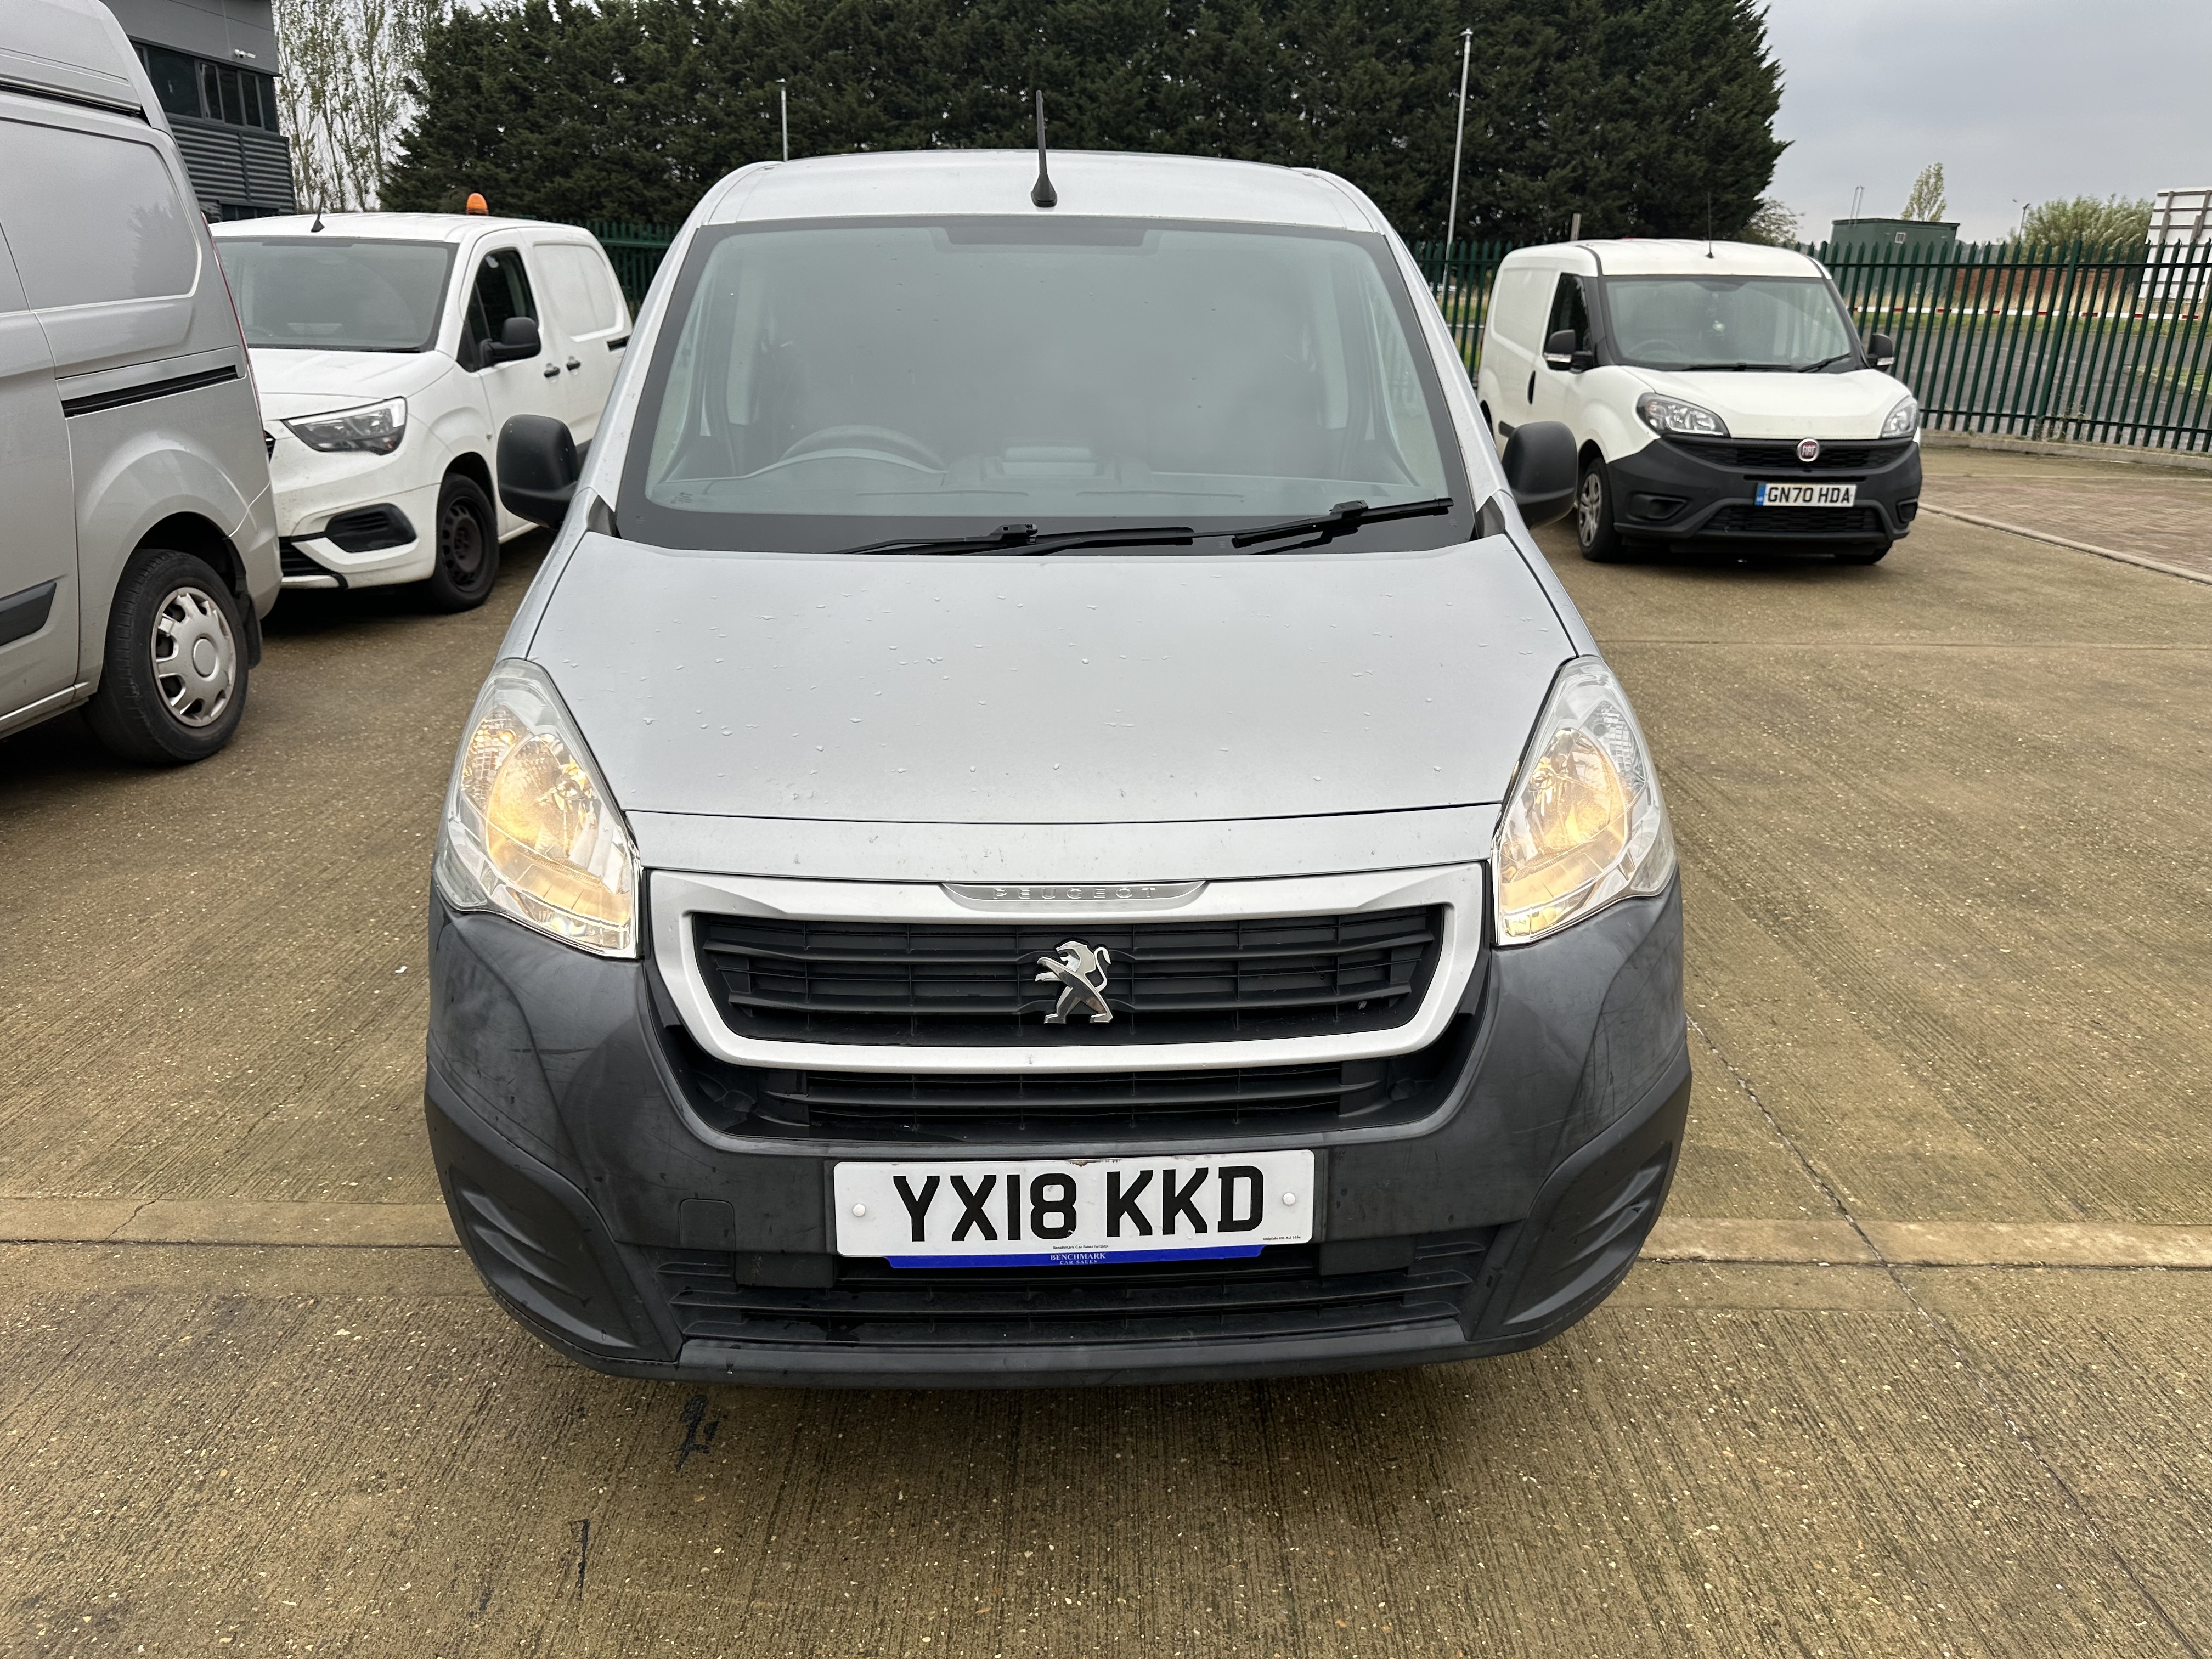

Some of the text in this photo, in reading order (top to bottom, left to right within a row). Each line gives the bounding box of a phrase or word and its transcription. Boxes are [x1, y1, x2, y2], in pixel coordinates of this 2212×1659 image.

[1802, 445, 1816, 456] FIAT
[1768, 487, 1850, 503] GN70 HDA
[993, 887, 1156, 900] PEUGEOT
[893, 1166, 1264, 1242] YX18 KKD
[1050, 1252, 1106, 1261] BENCHMARK
